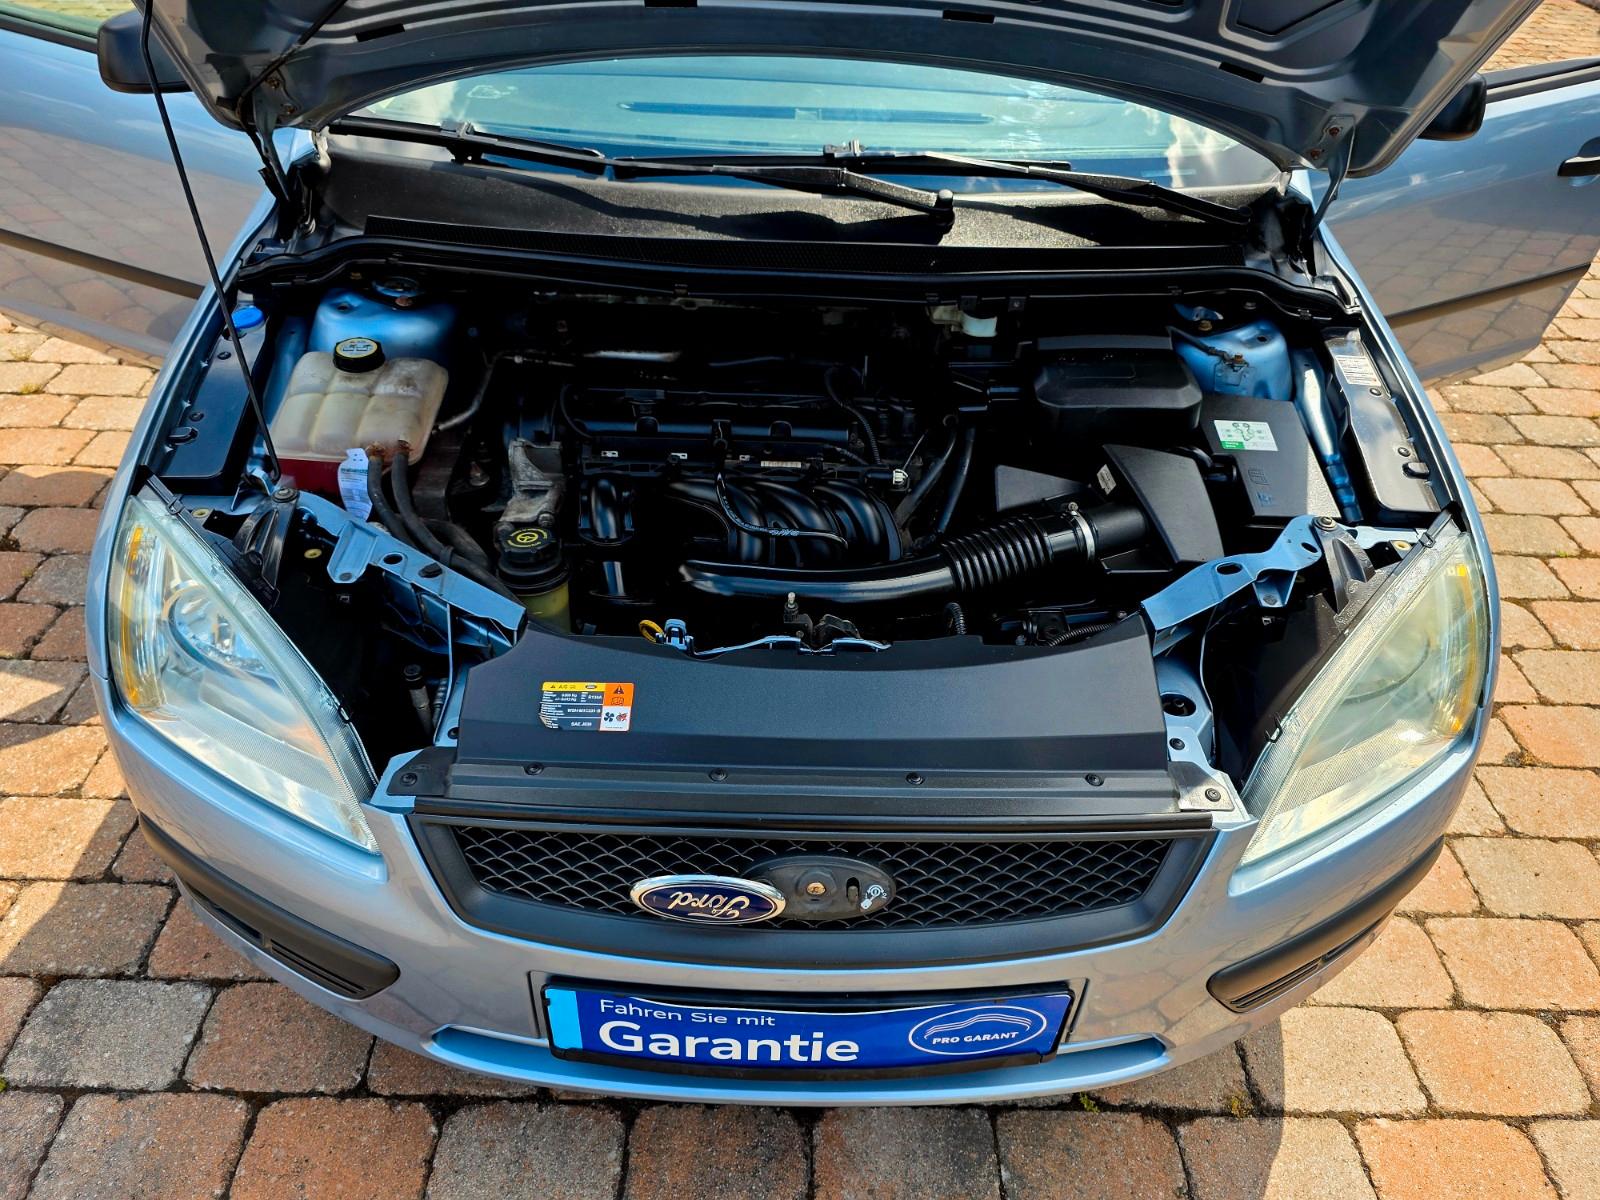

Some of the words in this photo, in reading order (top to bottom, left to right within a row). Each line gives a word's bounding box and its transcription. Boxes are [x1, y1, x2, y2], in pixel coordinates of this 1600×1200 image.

[667, 891, 750, 920] Ford
[600, 999, 682, 1021] Fahren
[691, 1012, 728, 1024] Sie
[737, 1015, 776, 1026] mit
[599, 1020, 859, 1062] Garantie
[932, 1036, 960, 1045] PRO
[963, 1031, 1019, 1042] GARANT
